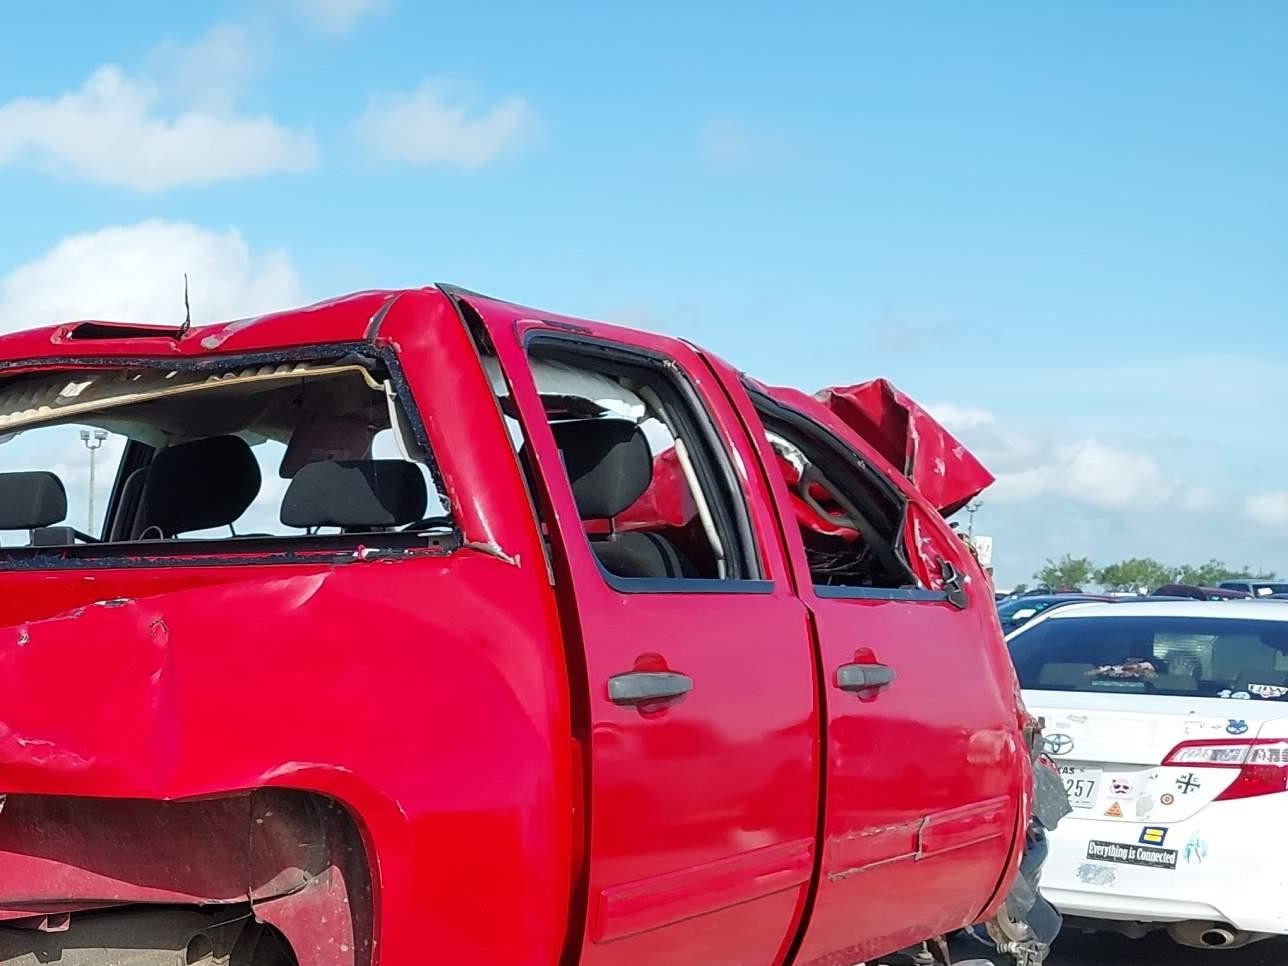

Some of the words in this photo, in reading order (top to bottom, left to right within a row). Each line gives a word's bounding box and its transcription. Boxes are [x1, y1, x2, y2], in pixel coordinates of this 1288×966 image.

[1065, 779, 1095, 798] 257
[1088, 842, 1128, 860] Everything
[1128, 847, 1136, 859] is
[1136, 848, 1177, 864] Connected
